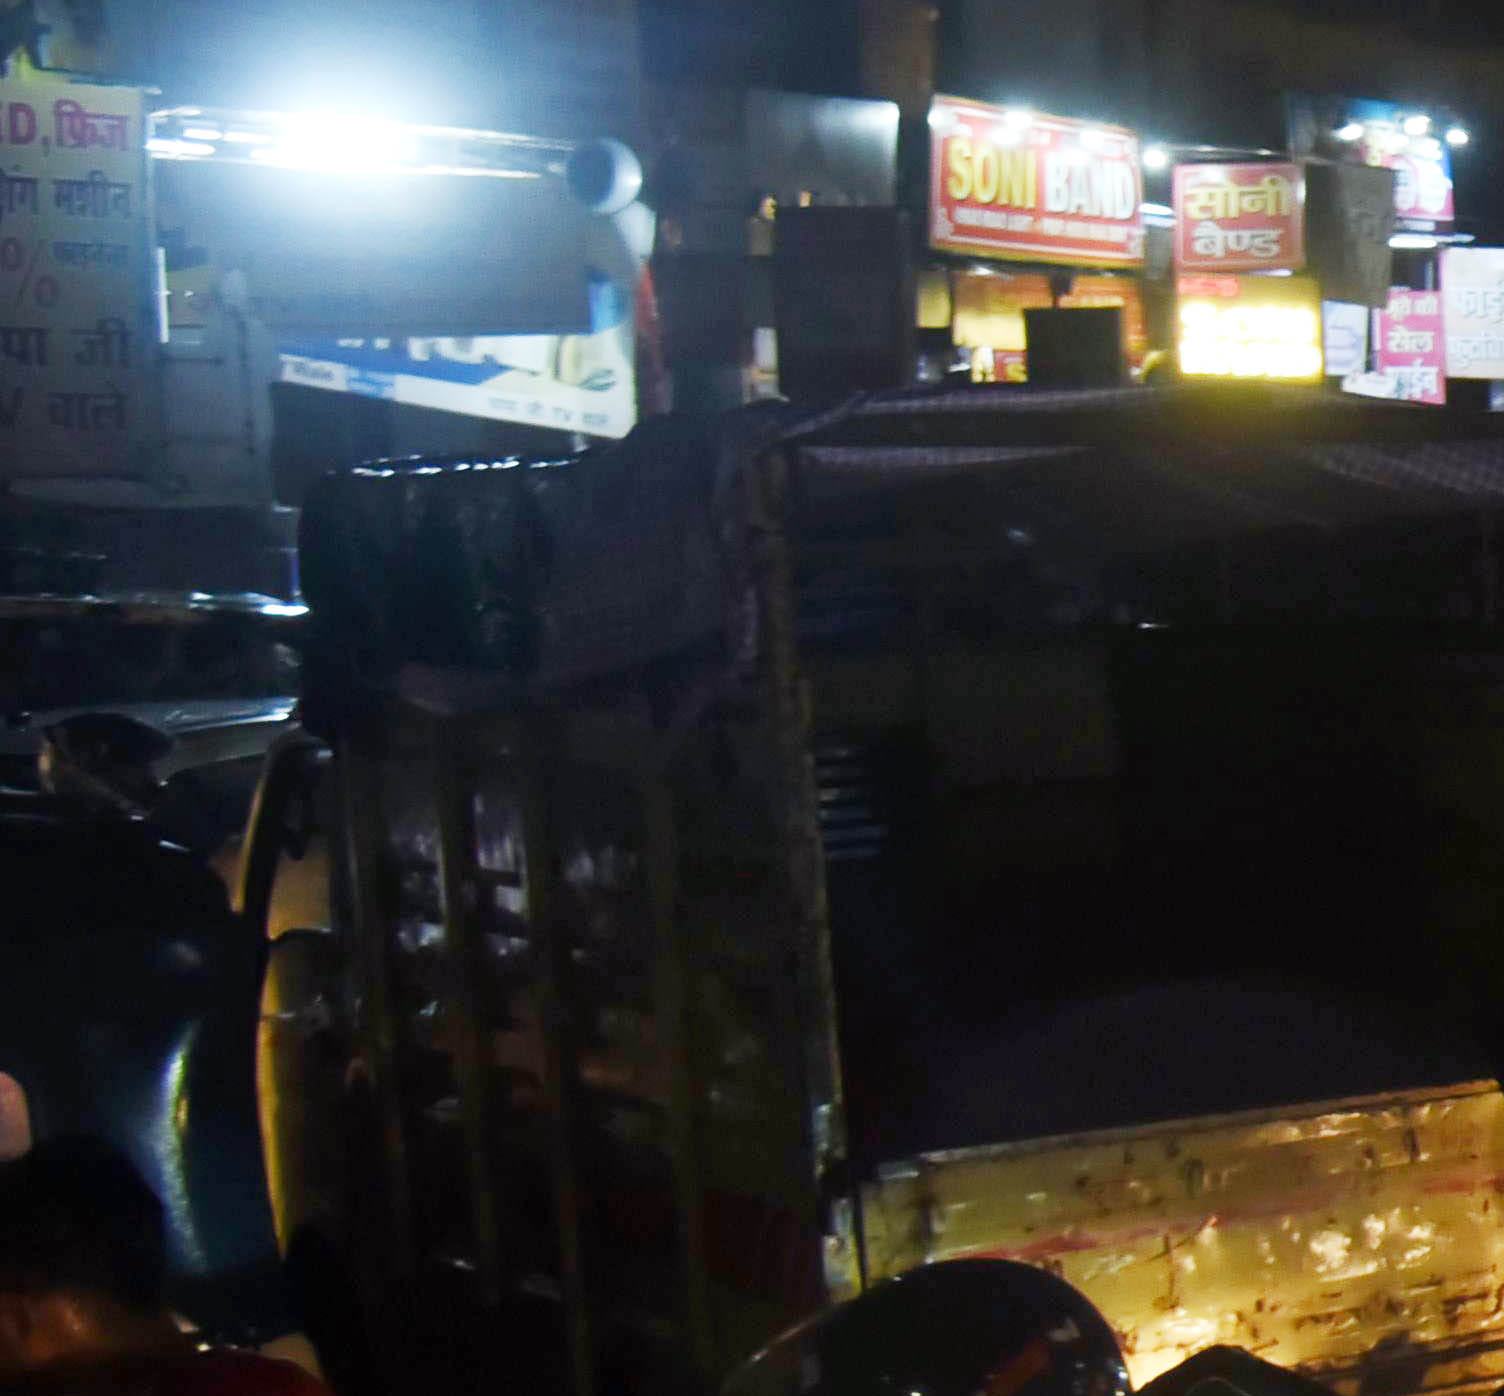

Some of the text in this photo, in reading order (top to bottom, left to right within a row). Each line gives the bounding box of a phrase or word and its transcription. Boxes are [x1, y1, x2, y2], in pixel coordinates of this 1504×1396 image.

[947, 132, 1136, 220] SONI BAND
[1174, 173, 1293, 220] सोनी
[1191, 219, 1286, 259] बैण्ड
